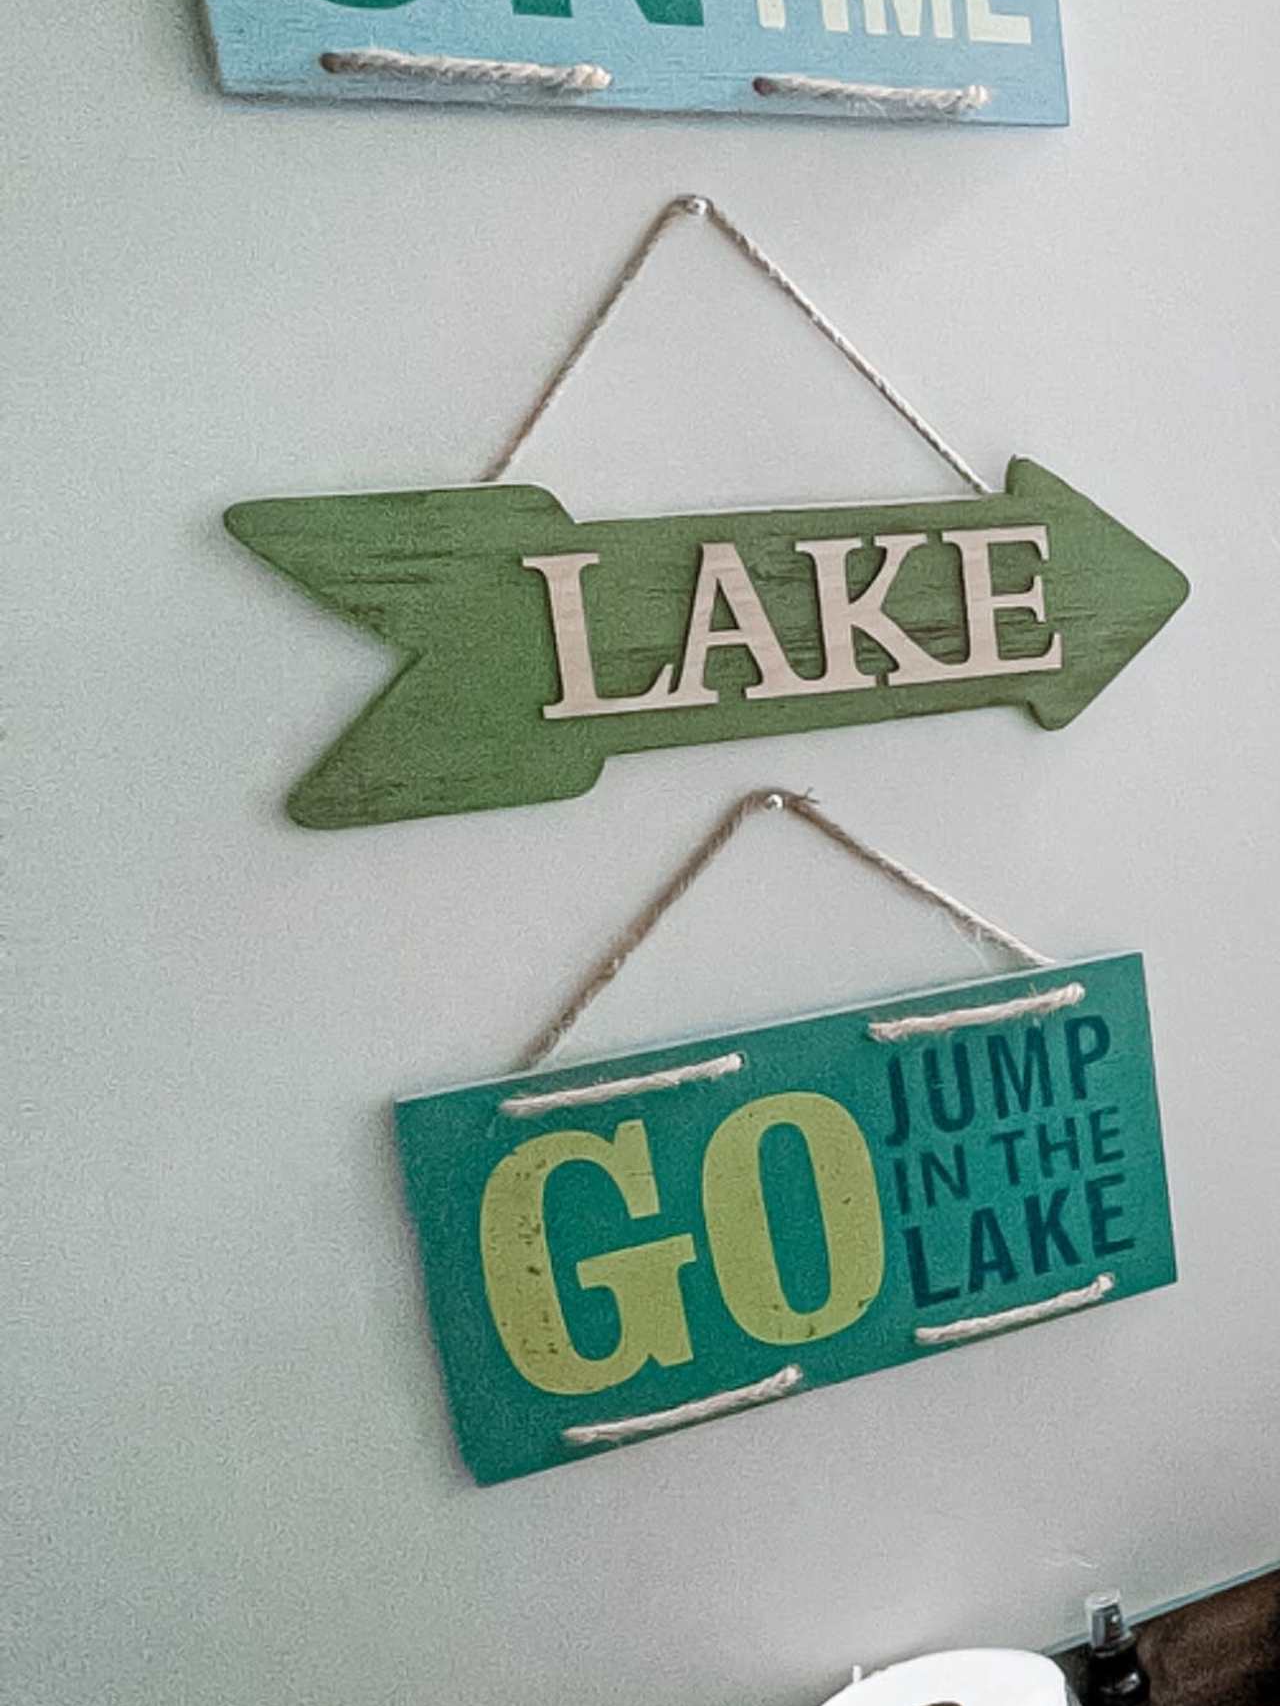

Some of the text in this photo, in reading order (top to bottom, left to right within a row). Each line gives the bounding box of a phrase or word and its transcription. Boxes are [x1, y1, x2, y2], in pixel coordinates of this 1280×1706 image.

[522, 524, 1063, 720] LAKE
[885, 1014, 1112, 1146] JUMP
[894, 1106, 1125, 1215] IN THE
[479, 1091, 886, 1395] GO
[904, 1174, 1136, 1308] LAKE
